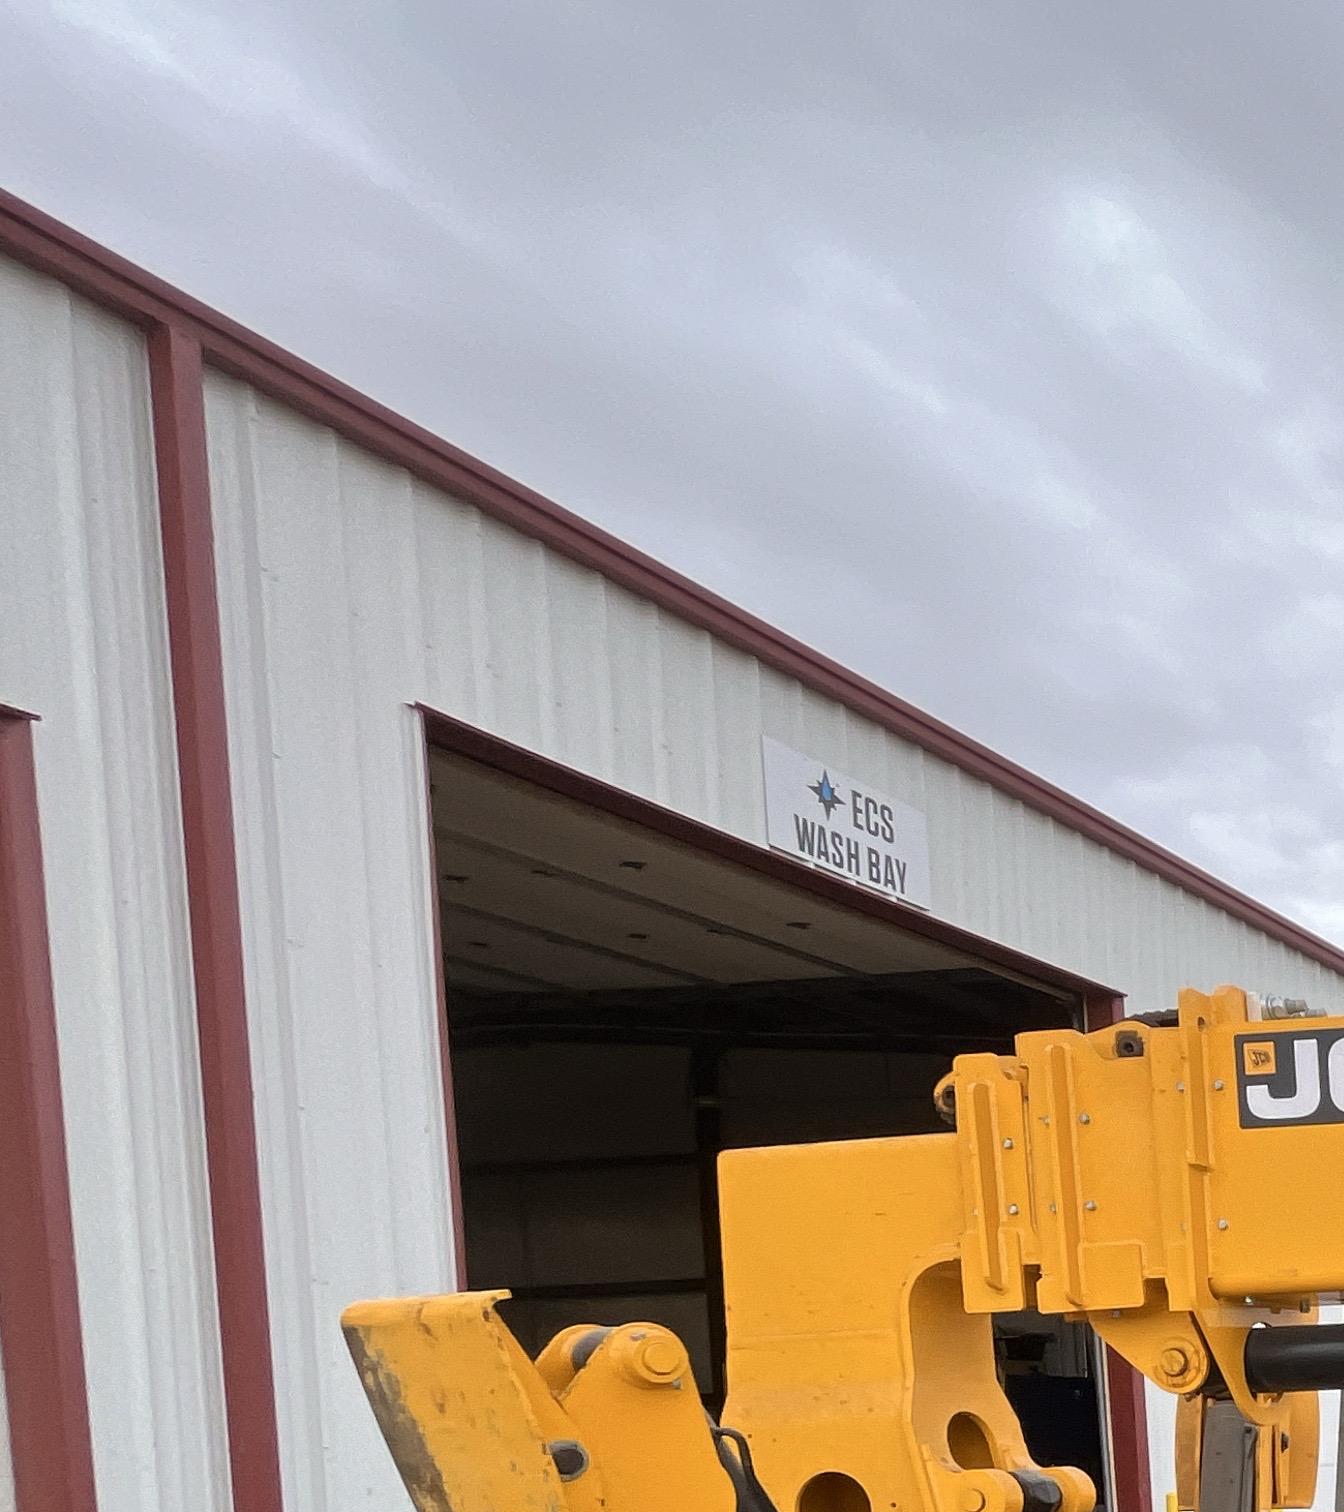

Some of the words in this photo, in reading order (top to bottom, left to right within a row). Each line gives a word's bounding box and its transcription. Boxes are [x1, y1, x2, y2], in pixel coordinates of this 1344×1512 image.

[851, 788, 895, 844] ECS
[793, 813, 861, 877] WASH
[867, 846, 908, 895] BAY
